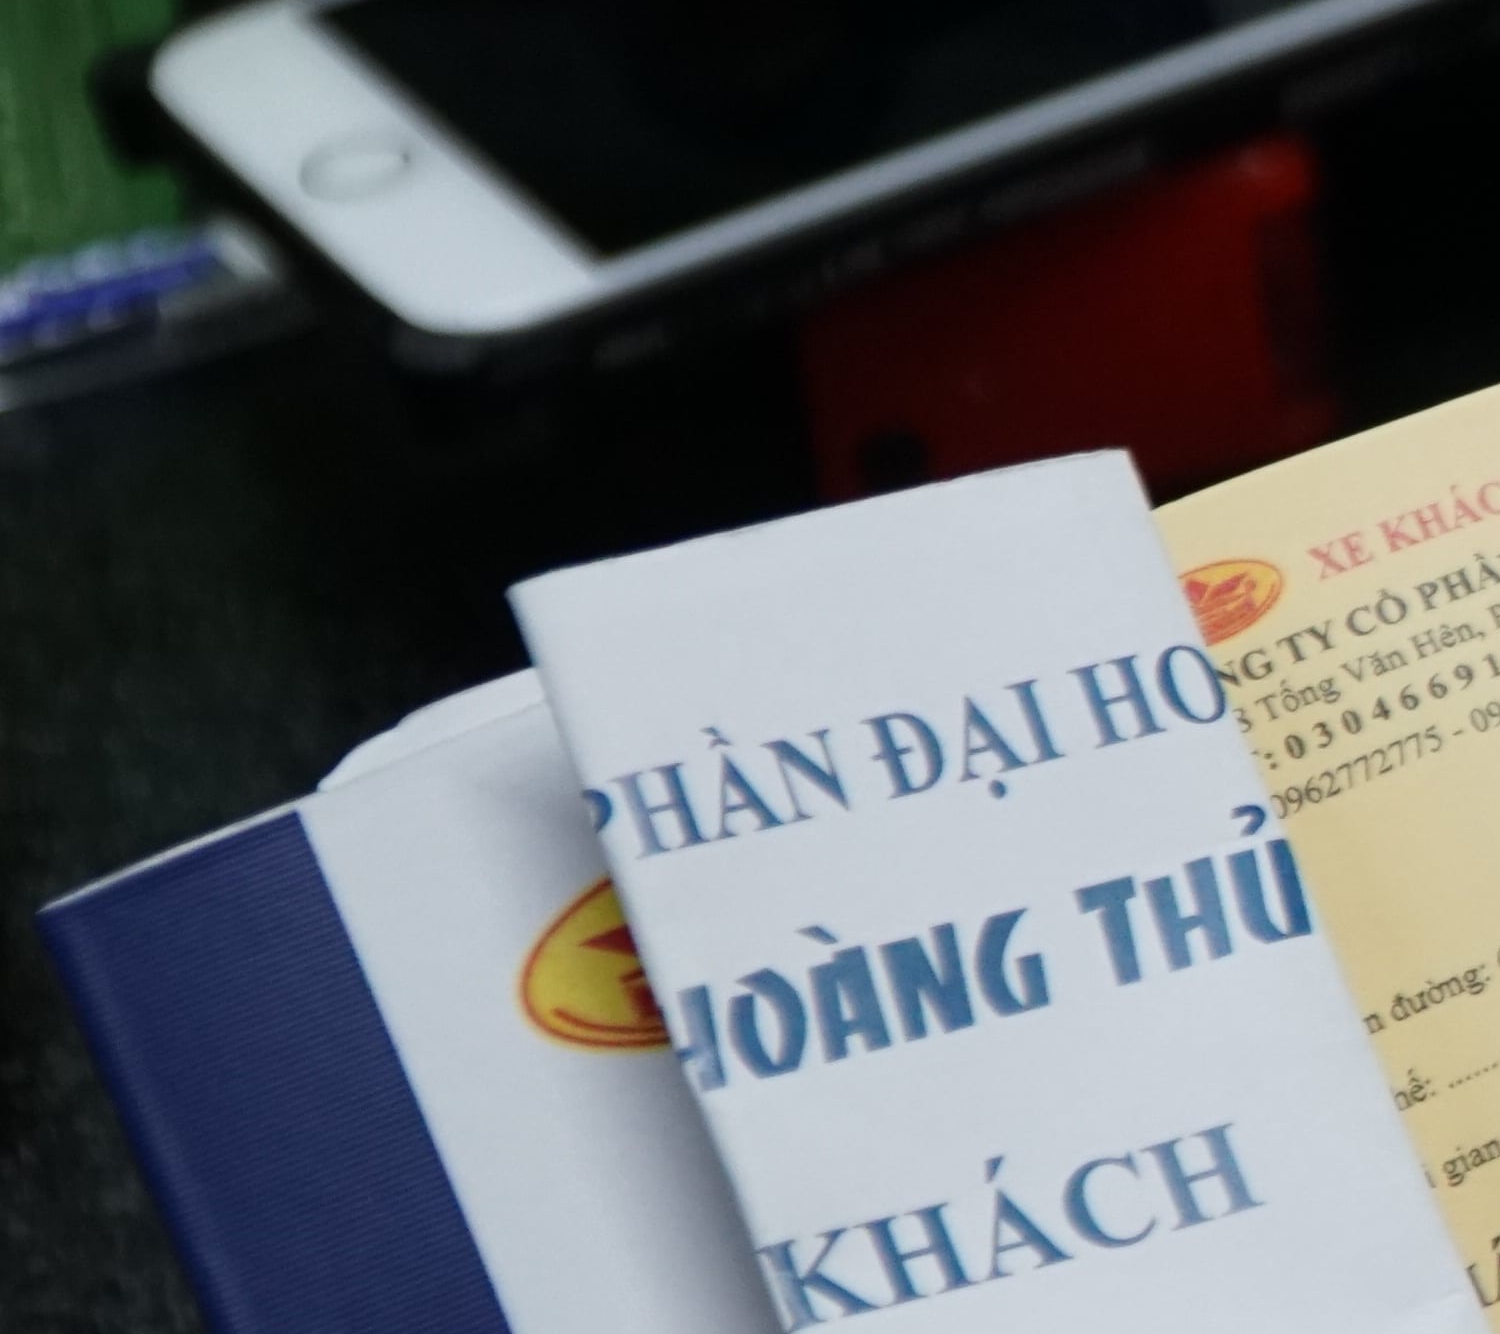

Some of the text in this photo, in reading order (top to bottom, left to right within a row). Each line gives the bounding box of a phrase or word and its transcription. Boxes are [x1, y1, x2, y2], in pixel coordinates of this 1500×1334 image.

[1309, 533, 1367, 574] XE
[1255, 676, 1343, 722] Tống
[1340, 649, 1409, 683] Văn
[1409, 622, 1487, 660] Hên,
[1277, 620, 1335, 663] TY
[867, 678, 1065, 799] ĐẠI
[1087, 644, 1236, 746] HO
[665, 913, 1051, 1098] HOÀNG
[1390, 964, 1491, 1022] đường:
